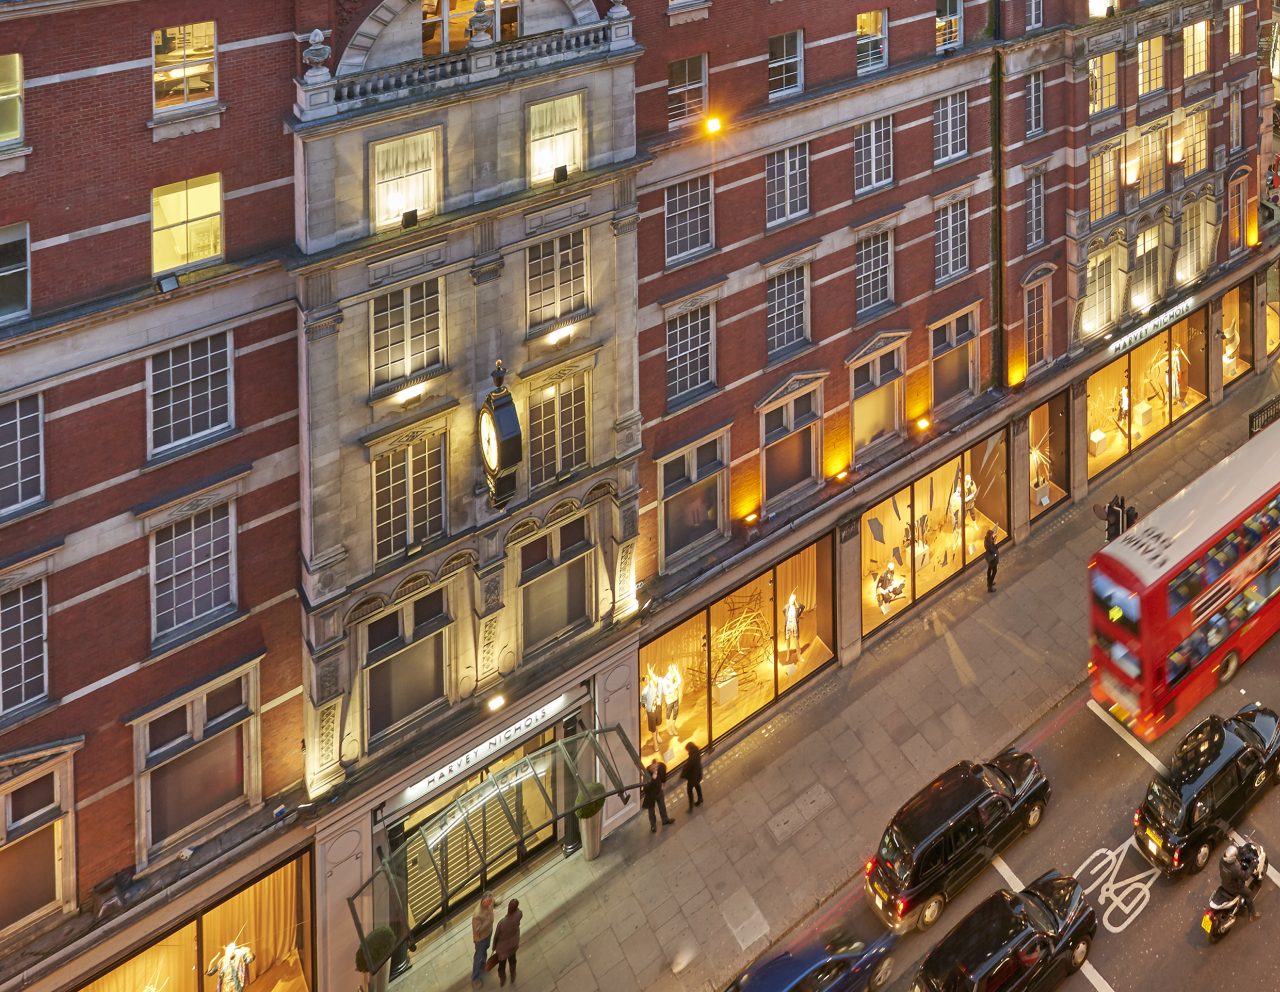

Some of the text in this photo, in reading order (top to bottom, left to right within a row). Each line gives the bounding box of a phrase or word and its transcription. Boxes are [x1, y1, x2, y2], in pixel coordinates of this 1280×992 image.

[1114, 303, 1191, 353] HARVEY NICHOLS
[427, 708, 547, 787] HARVEY NICHOLS
